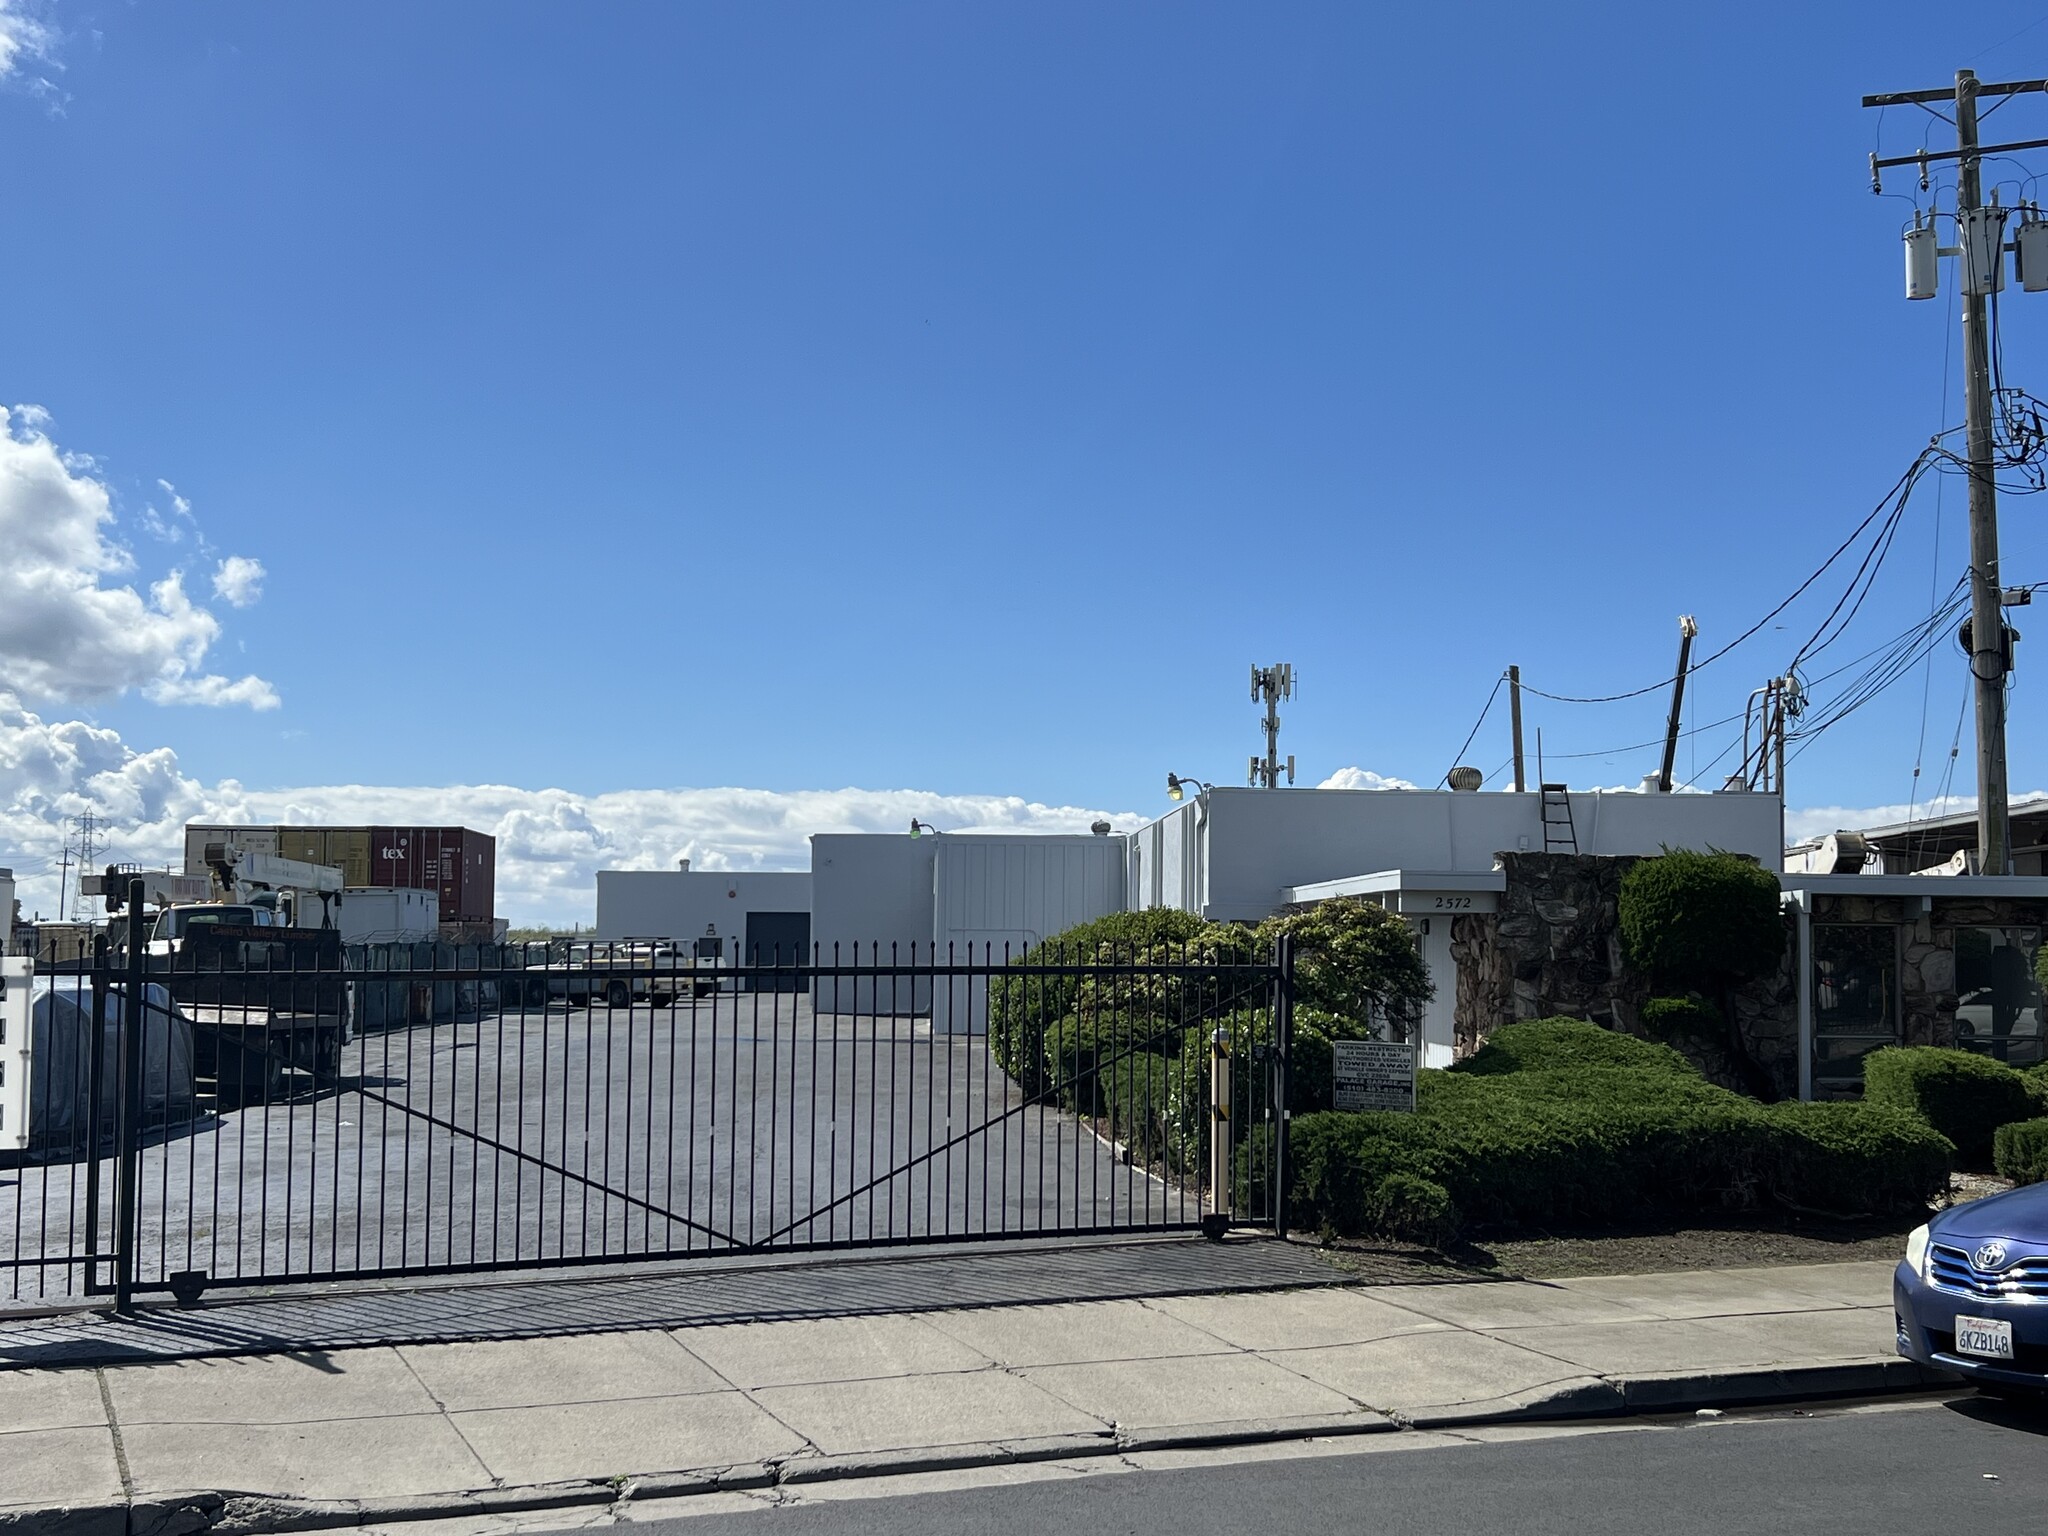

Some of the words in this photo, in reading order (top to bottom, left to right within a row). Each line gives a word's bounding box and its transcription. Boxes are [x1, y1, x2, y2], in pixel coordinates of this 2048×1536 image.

[381, 846, 405, 860] tex
[1435, 896, 1471, 909] 2572
[210, 925, 243, 937] Castro
[246, 927, 277, 939] Valley
[281, 929, 317, 940] Lumber
[1959, 1330, 2009, 1354] 6KZB148
